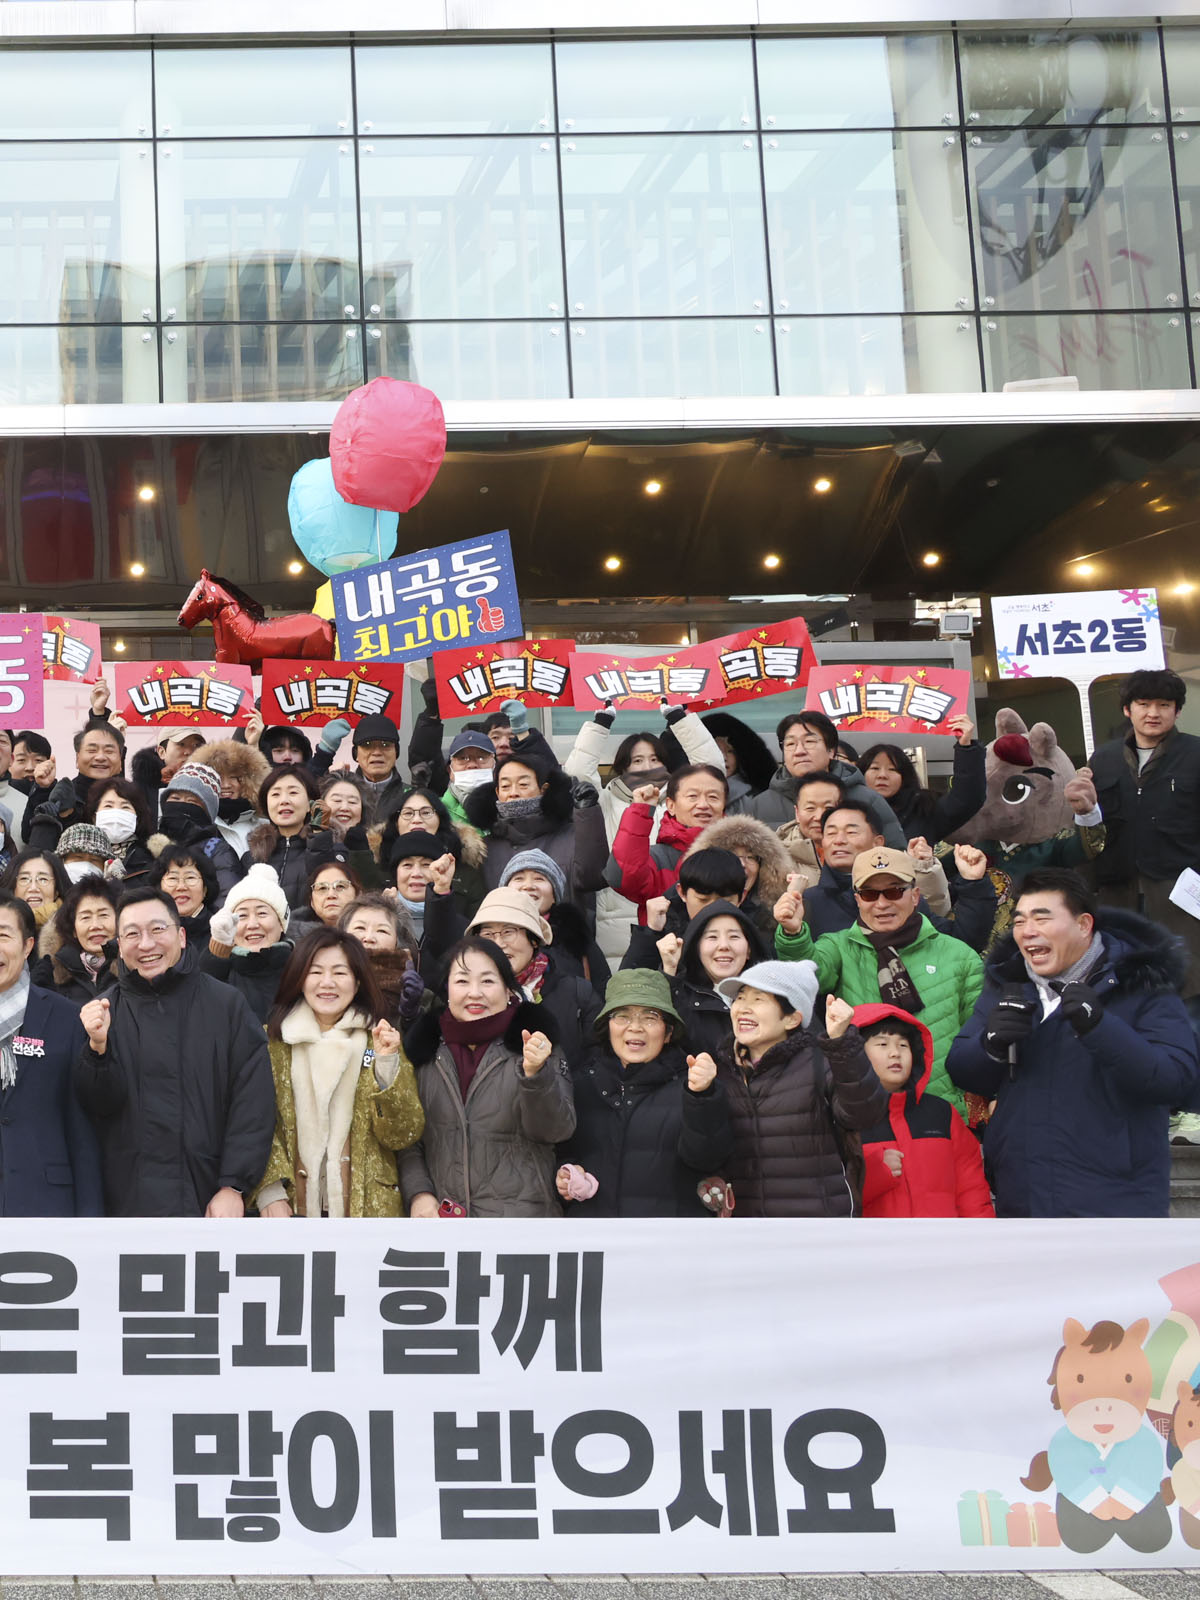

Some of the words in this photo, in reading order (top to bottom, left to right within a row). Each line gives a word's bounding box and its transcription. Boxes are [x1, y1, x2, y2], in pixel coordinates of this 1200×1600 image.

[342, 544, 502, 622] 내곡동
[1031, 602, 1051, 612] 서초
[353, 604, 474, 661] 최고야
[1015, 617, 1147, 656] 서초2동
[42, 631, 92, 674] 곡동
[719, 647, 801, 681] 곡동
[127, 677, 243, 716] 내곡동
[274, 677, 391, 716] 내곡동
[447, 657, 570, 704] 내곡동
[584, 668, 707, 700] 내곡동
[818, 682, 953, 722] 내곡동
[12, 1041, 46, 1058] 전성수
[119, 1252, 345, 1375] 말과
[379, 1249, 604, 1374] 함께
[27, 1412, 132, 1540] 복
[173, 1411, 397, 1542] 많이
[434, 1409, 896, 1539] 받으세요
